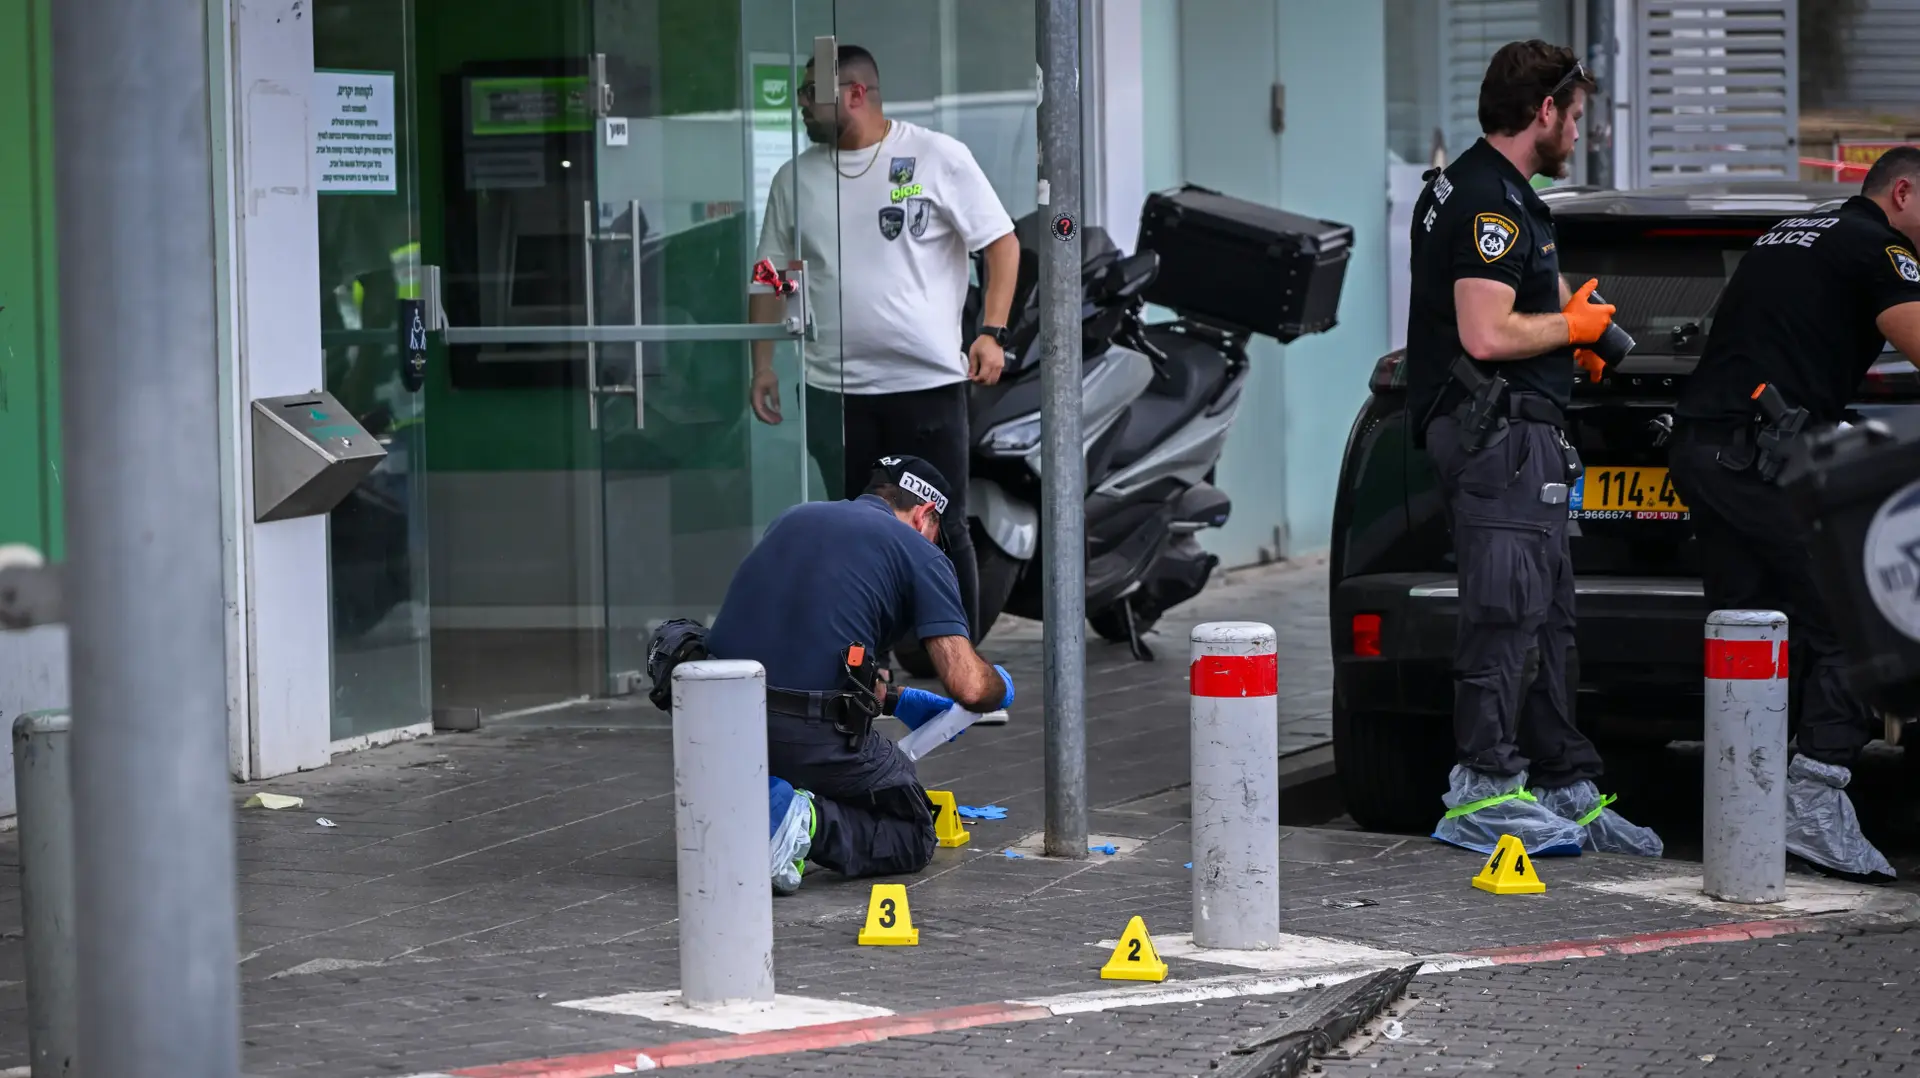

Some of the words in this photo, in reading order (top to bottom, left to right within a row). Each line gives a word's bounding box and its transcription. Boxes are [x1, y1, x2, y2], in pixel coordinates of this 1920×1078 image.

[891, 184, 922, 202] DIOR
[1752, 231, 1821, 248] OLICE
[903, 475, 946, 510] משטרה
[1490, 847, 1506, 875] 4
[1514, 854, 1525, 876] 4
[879, 898, 896, 928] 3
[1128, 938, 1141, 961] 2
